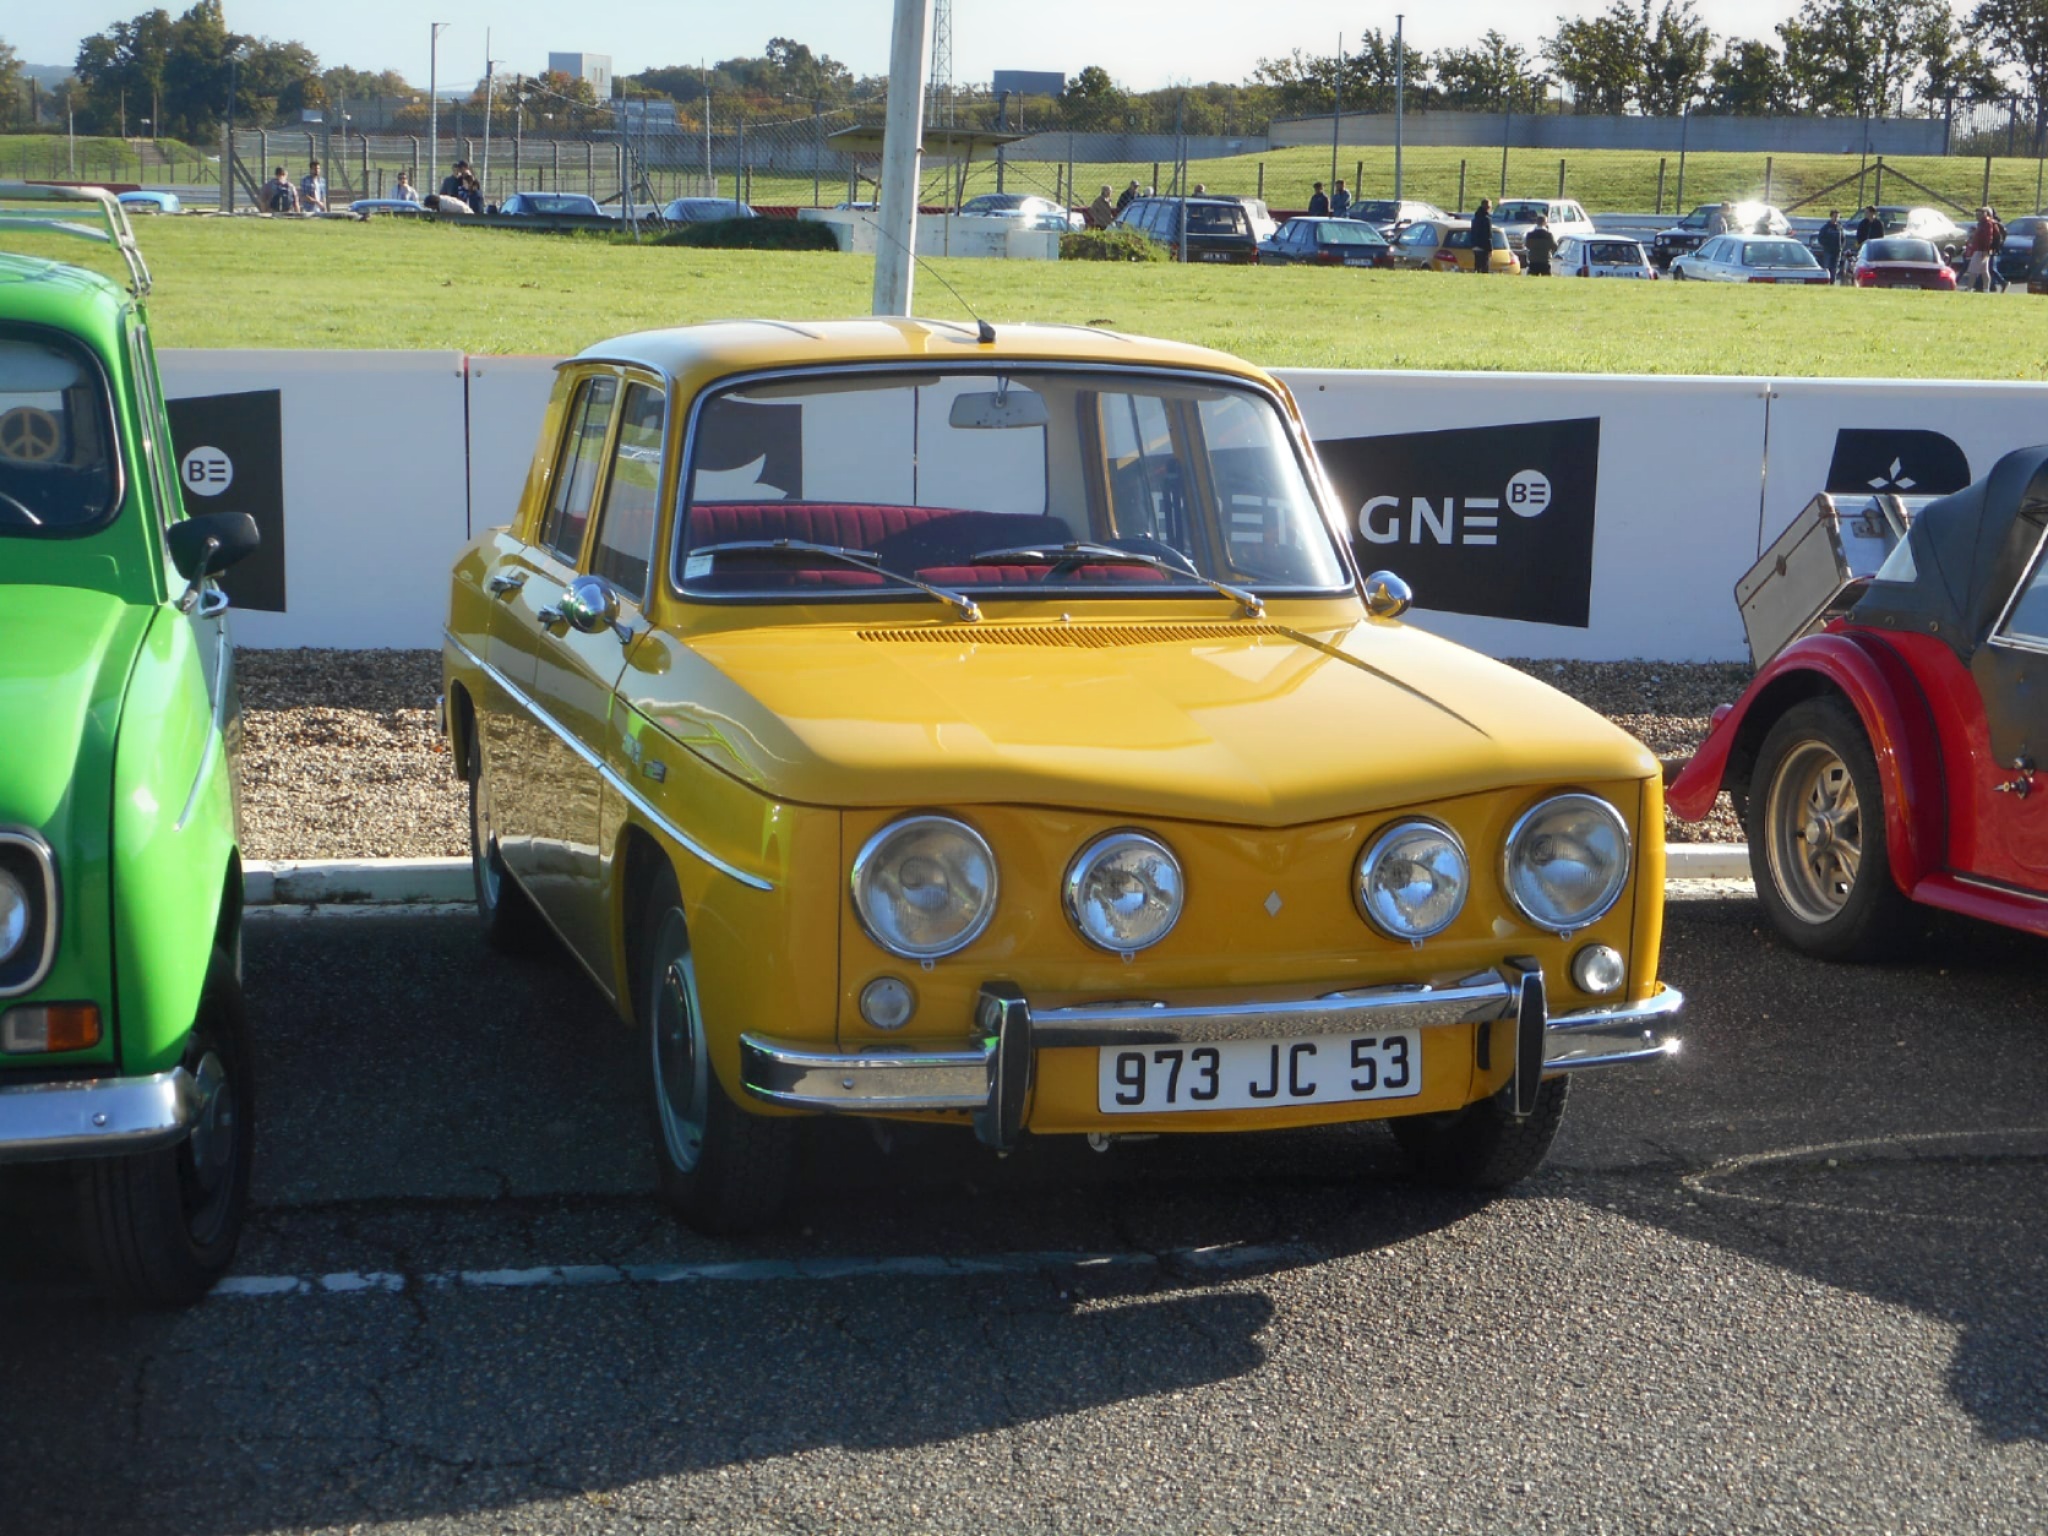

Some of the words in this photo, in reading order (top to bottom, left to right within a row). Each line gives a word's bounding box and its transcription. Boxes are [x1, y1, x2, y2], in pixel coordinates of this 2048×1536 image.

[188, 459, 226, 482] BE
[1510, 482, 1547, 504] BE
[1115, 1047, 1220, 1106] 973
[1249, 1042, 1317, 1099] JC
[1350, 1035, 1410, 1092] 53
